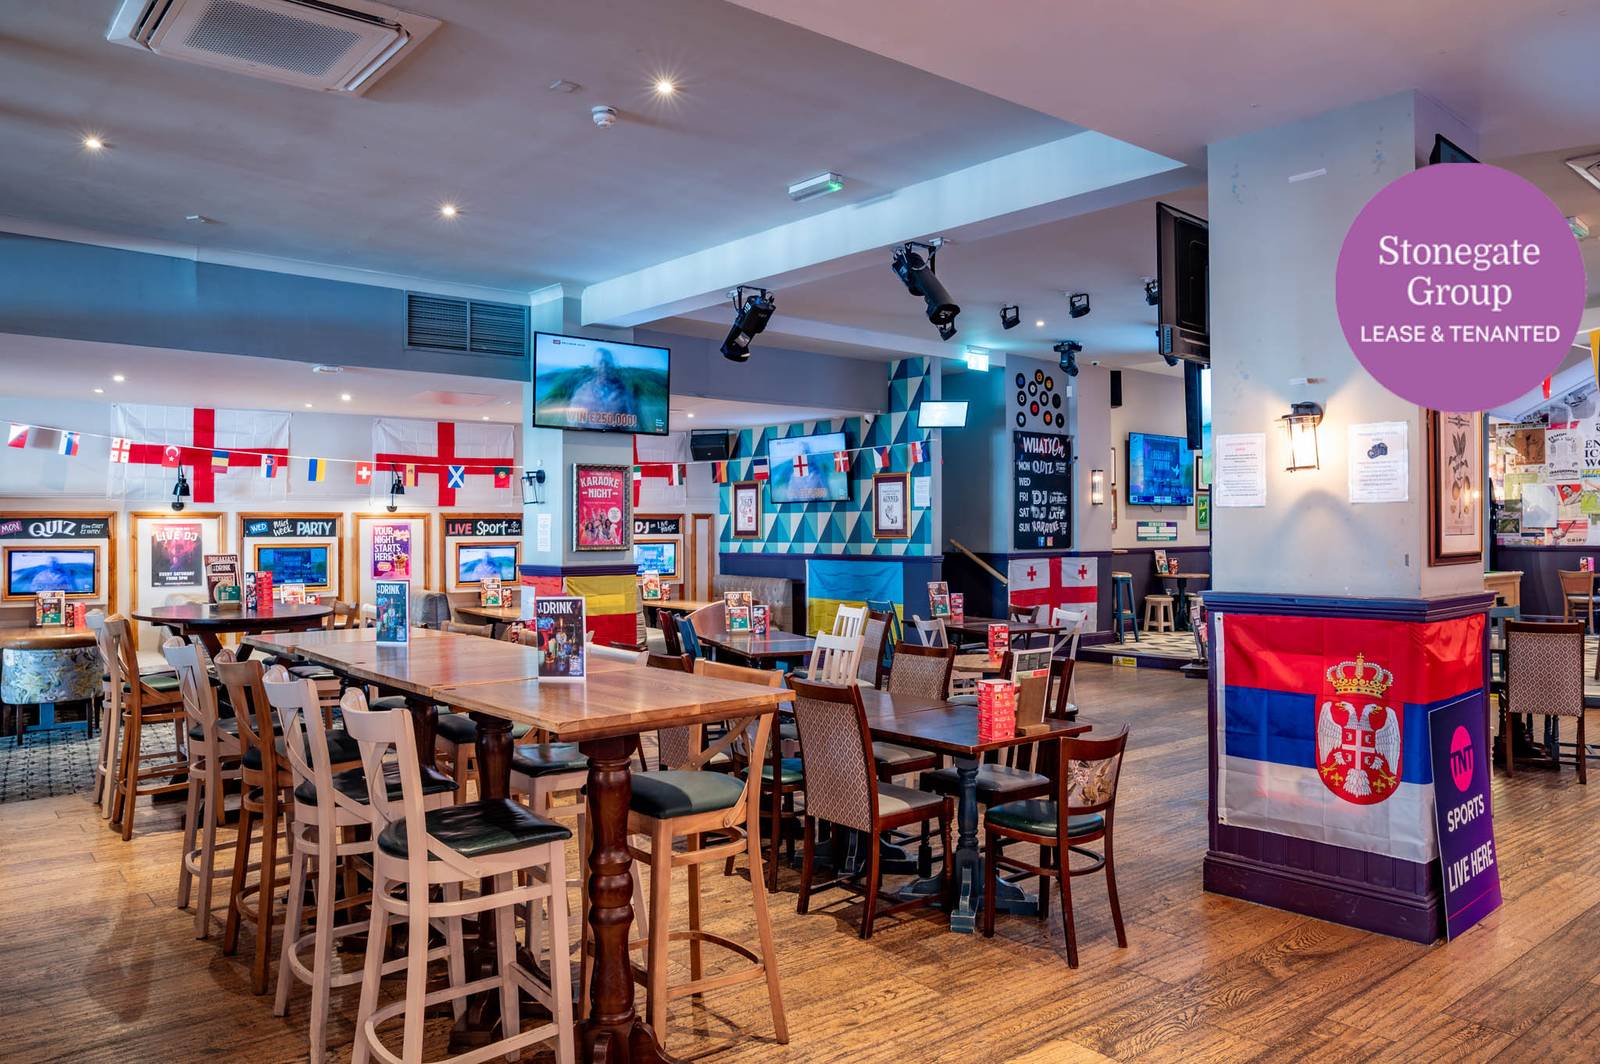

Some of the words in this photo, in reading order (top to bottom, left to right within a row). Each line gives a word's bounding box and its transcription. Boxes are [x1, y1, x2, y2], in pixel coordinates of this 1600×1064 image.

[567, 407, 588, 424] WIN
[1018, 461, 1030, 470] MON
[1032, 460, 1054, 474] QUIZ
[580, 476, 620, 489] KARAOKE
[1018, 477, 1031, 486] WED
[1019, 492, 1029, 501] FRI
[1032, 490, 1048, 505] DJ
[1019, 507, 1030, 517] SAT
[1, 522, 20, 533] MON
[29, 519, 77, 537] QUIZ
[250, 522, 267, 532] WED
[296, 521, 333, 536] PARTY
[374, 527, 393, 535] YOUR
[449, 523, 473, 534] LIVE
[476, 520, 509, 535] Sport
[1019, 522, 1030, 532] SUN
[155, 530, 180, 541] LIVE
[184, 531, 198, 541] DJ
[374, 535, 395, 543] NIGHT
[374, 544, 401, 552] STARTS
[374, 553, 392, 561] HERE
[380, 585, 400, 594] DRINK
[543, 601, 573, 614] DRINK
[1450, 745, 1473, 777] TNT
[1447, 794, 1485, 832] SPORTS
[1448, 855, 1471, 893] LIVE
[1471, 840, 1494, 878] HERE
